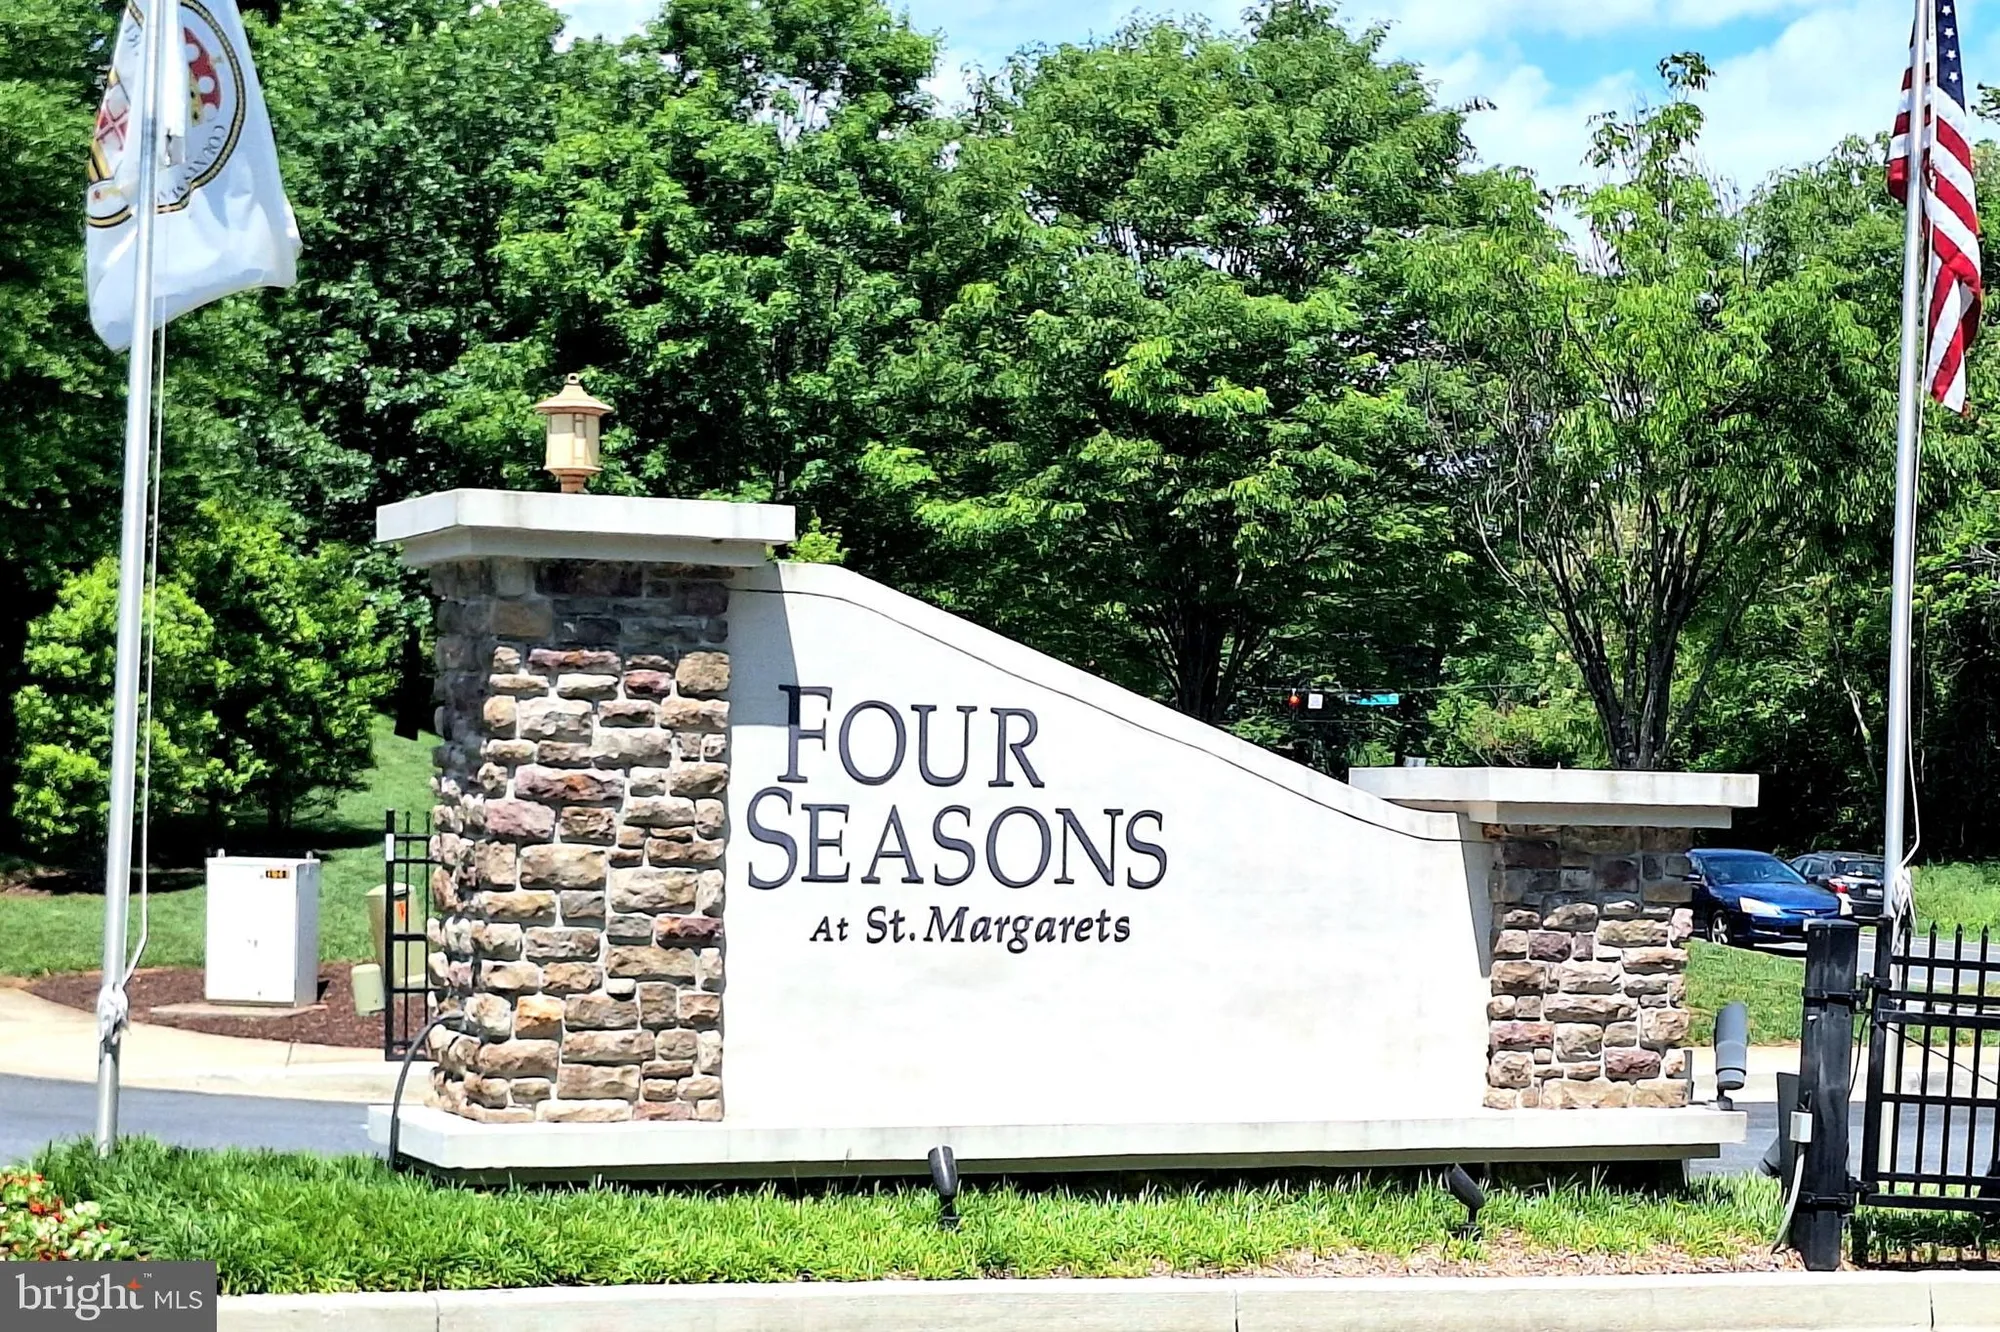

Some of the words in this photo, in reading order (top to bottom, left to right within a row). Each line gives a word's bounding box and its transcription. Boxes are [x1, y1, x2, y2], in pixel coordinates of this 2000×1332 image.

[777, 684, 1045, 788] FOUR
[747, 786, 1167, 889] SEASONS
[809, 915, 849, 943] At
